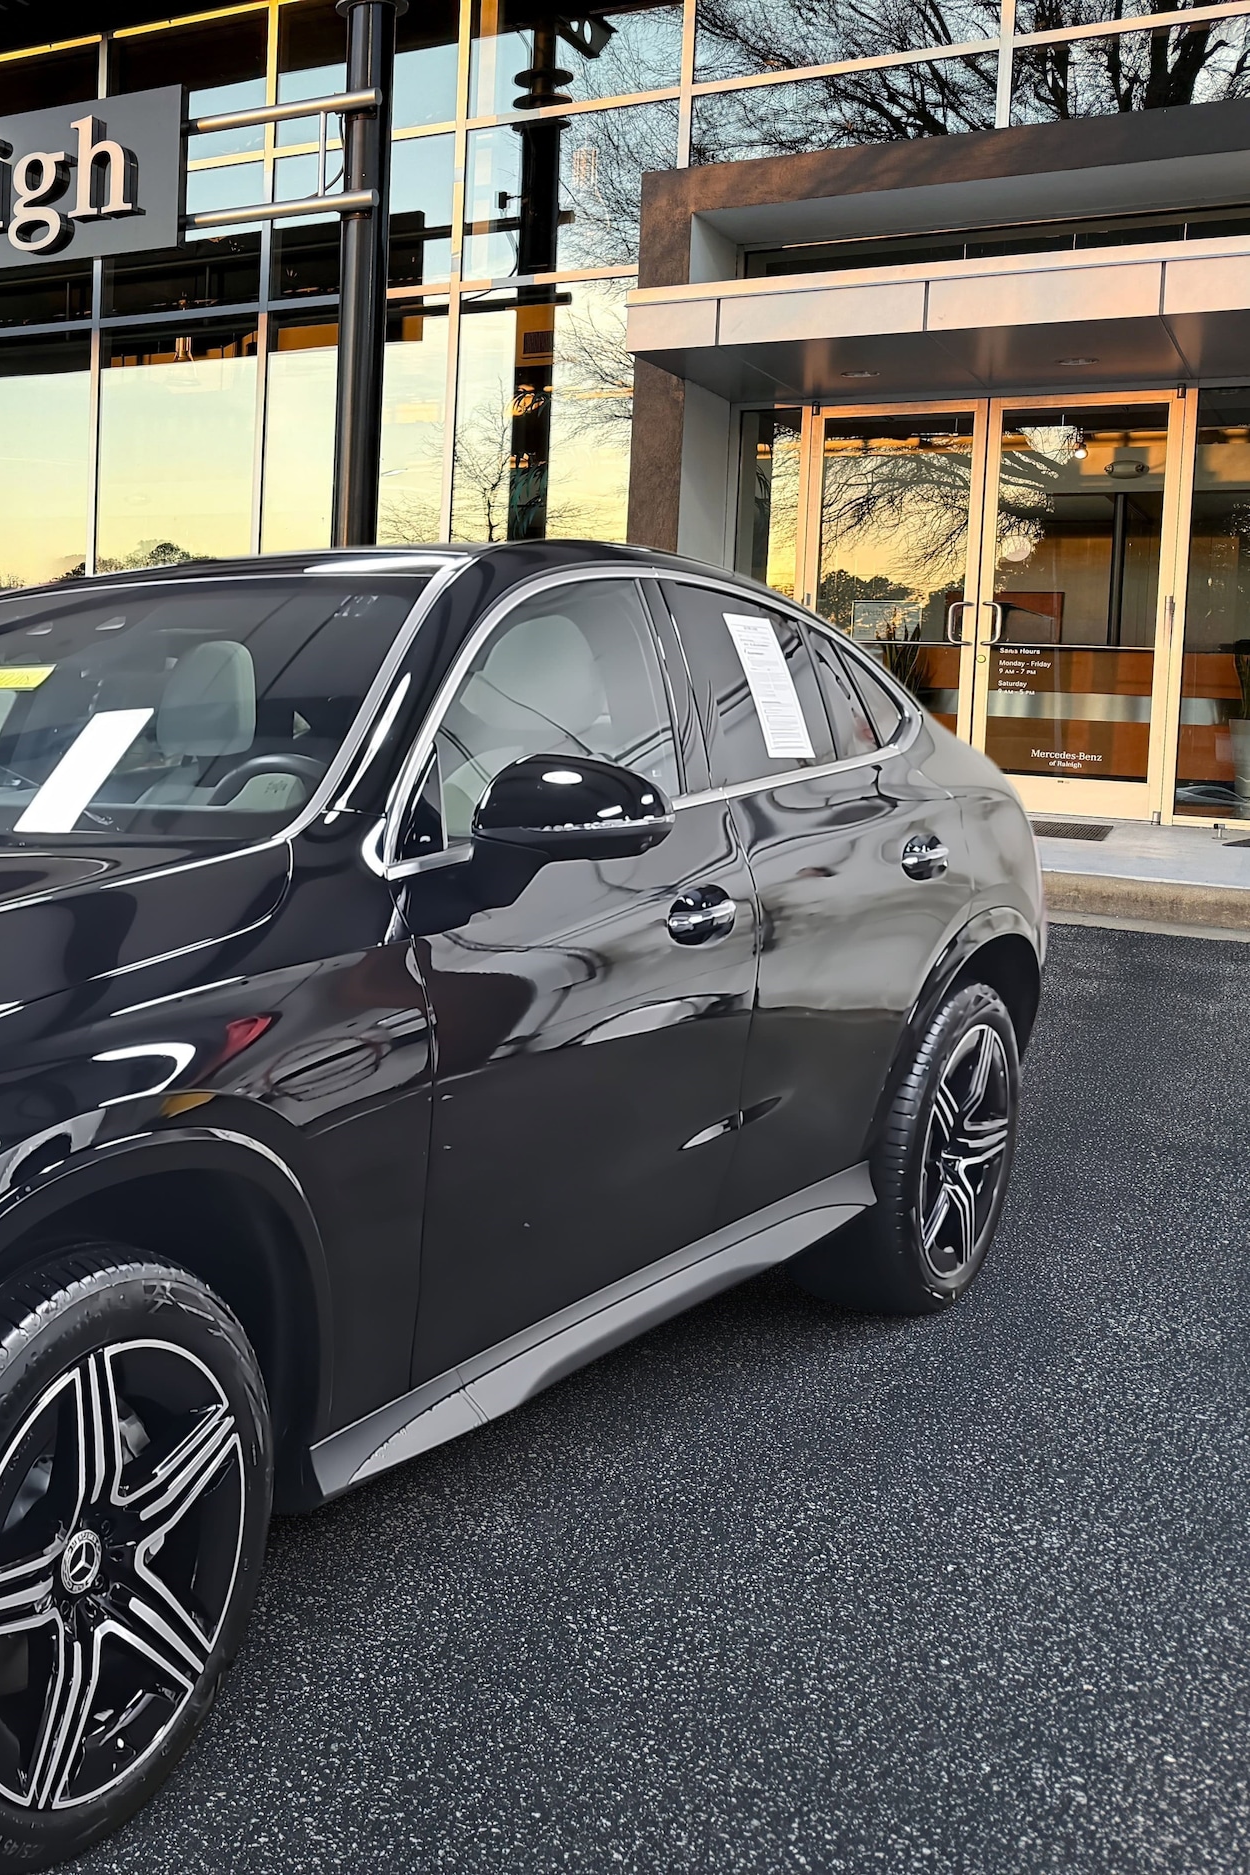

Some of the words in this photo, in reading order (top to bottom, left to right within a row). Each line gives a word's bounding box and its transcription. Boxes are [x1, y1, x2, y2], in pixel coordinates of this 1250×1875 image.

[998, 680, 1027, 688] Saturday
[1030, 748, 1103, 762] Mercedes-Benz
[1057, 761, 1082, 769] Raleigh
